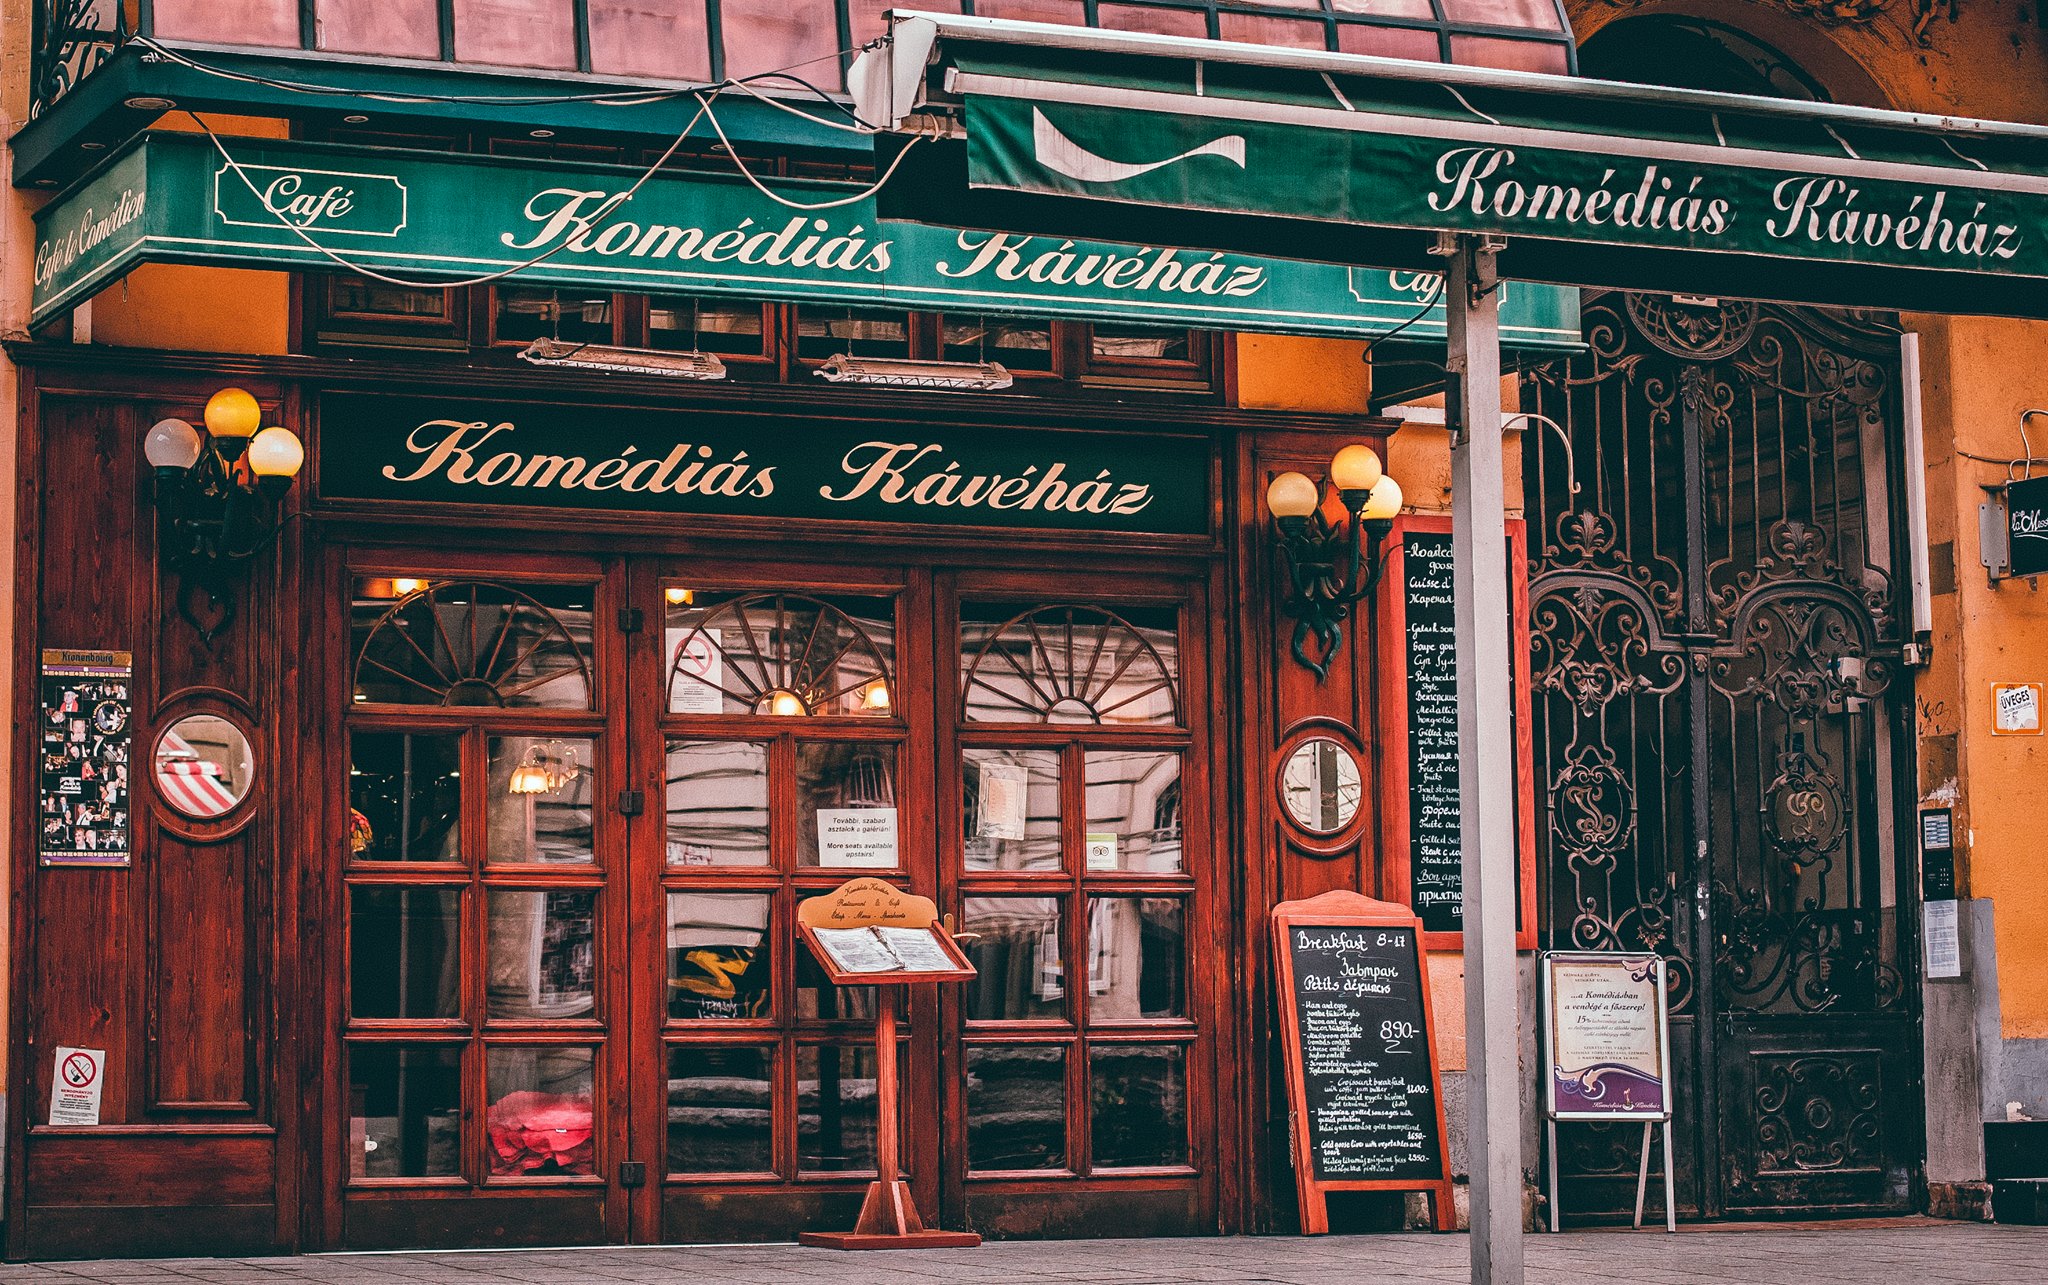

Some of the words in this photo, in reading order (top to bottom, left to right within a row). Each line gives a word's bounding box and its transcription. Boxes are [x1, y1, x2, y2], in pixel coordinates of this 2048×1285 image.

[264, 175, 355, 227] Café
[1428, 148, 1729, 235] Komédiás
[1767, 177, 2021, 260] Kávéház
[35, 240, 64, 291] Café
[64, 230, 78, 266] le
[79, 189, 145, 255] Comédien
[501, 188, 894, 272] Komédiás
[936, 230, 1267, 298] Kávéház
[381, 419, 777, 497] Komédiás
[819, 440, 1154, 515] Kávéház
[1409, 576, 1441, 588] Cuisse
[62, 651, 113, 666] Kronenbourg
[1417, 869, 1440, 881] Bon
[1297, 930, 1368, 958] Breakfast
[1377, 933, 1405, 947] 8-17
[1304, 974, 1339, 990] Petits
[1585, 991, 1638, 999] Komédiásban
[1306, 1000, 1320, 1008] Ham
[1373, 1077, 1405, 1089] breakfast
[1318, 1108, 1349, 1118] Hungarian
[1321, 1140, 1333, 1148] Cold
